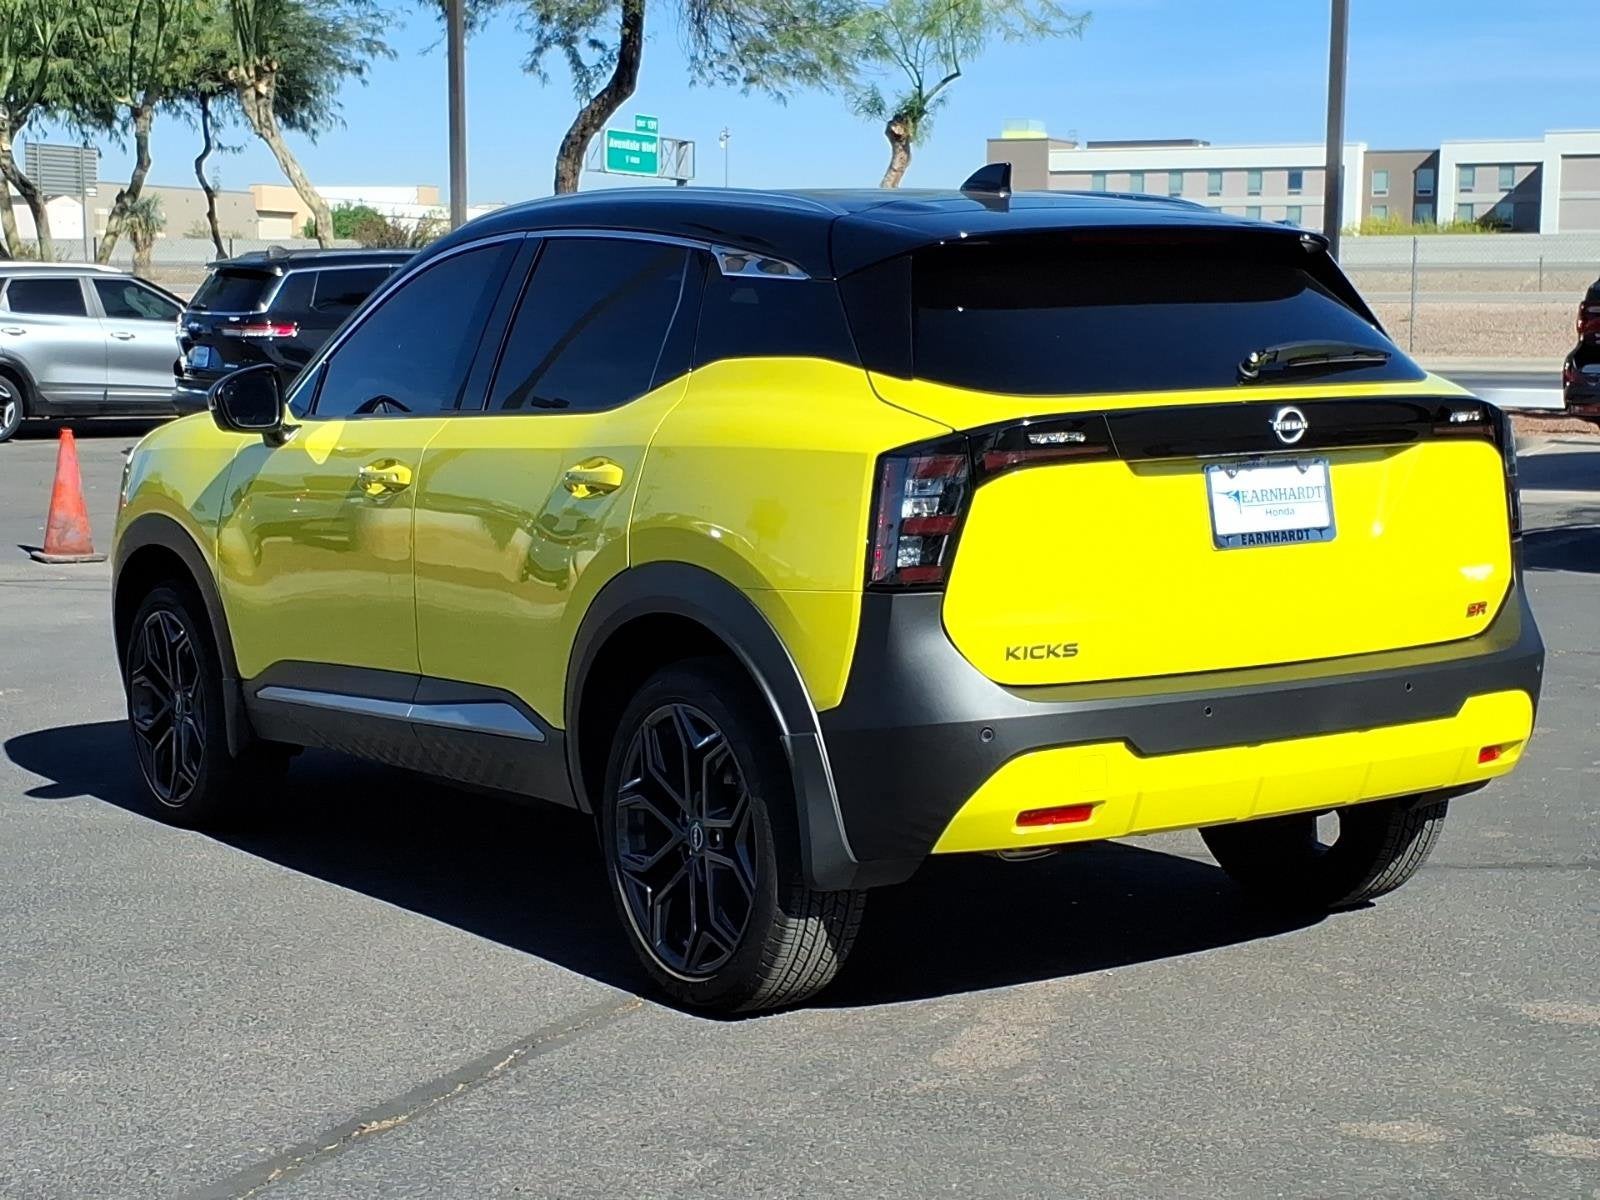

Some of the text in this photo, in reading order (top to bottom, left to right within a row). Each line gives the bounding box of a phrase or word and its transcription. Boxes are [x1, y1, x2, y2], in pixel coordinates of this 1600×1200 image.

[1273, 420, 1308, 431] NISSAN
[1241, 485, 1323, 503] EARNHARDT
[1265, 507, 1295, 517] Honda
[1241, 528, 1311, 545] EARNHARDT
[1005, 643, 1078, 661] KICKS
